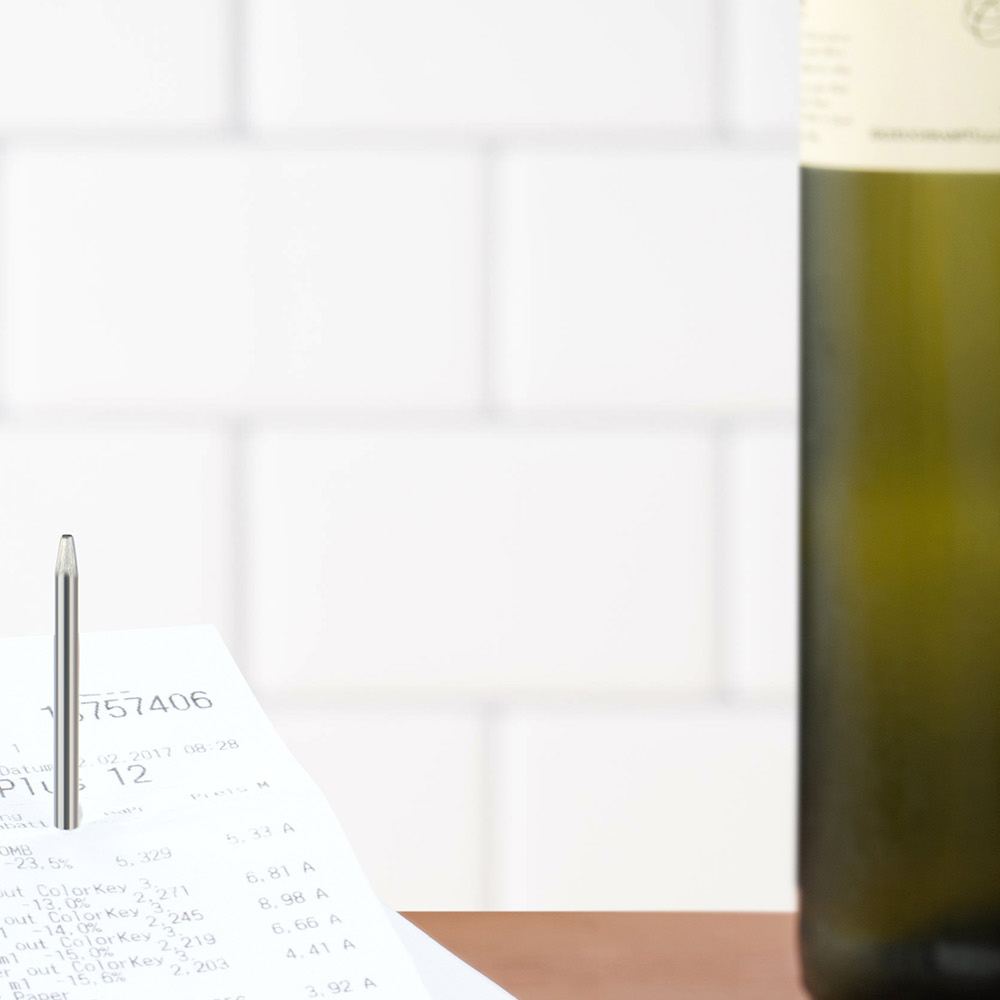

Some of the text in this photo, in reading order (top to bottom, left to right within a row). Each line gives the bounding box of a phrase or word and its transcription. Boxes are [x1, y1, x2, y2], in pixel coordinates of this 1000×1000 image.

[41, 691, 213, 722] 1757406
[107, 764, 152, 786] 12
[283, 822, 295, 834] A
[36, 882, 127, 898] ColorKey
[246, 864, 290, 884] 6.81
[302, 861, 316, 873] A
[4, 912, 37, 926] out
[47, 906, 139, 924] ColorKey
[258, 891, 306, 910] 8.98
[315, 887, 329, 900] A
[15, 939, 49, 951] out
[60, 931, 151, 949] ColorKey
[271, 917, 319, 935] 6.66
[329, 913, 342, 926] A
[26, 964, 60, 977] out
[72, 955, 163, 973] ColorKey
[286, 942, 331, 960] 4.41
[343, 938, 356, 951] A
[305, 979, 352, 998] 3.92
[363, 977, 377, 990] A
